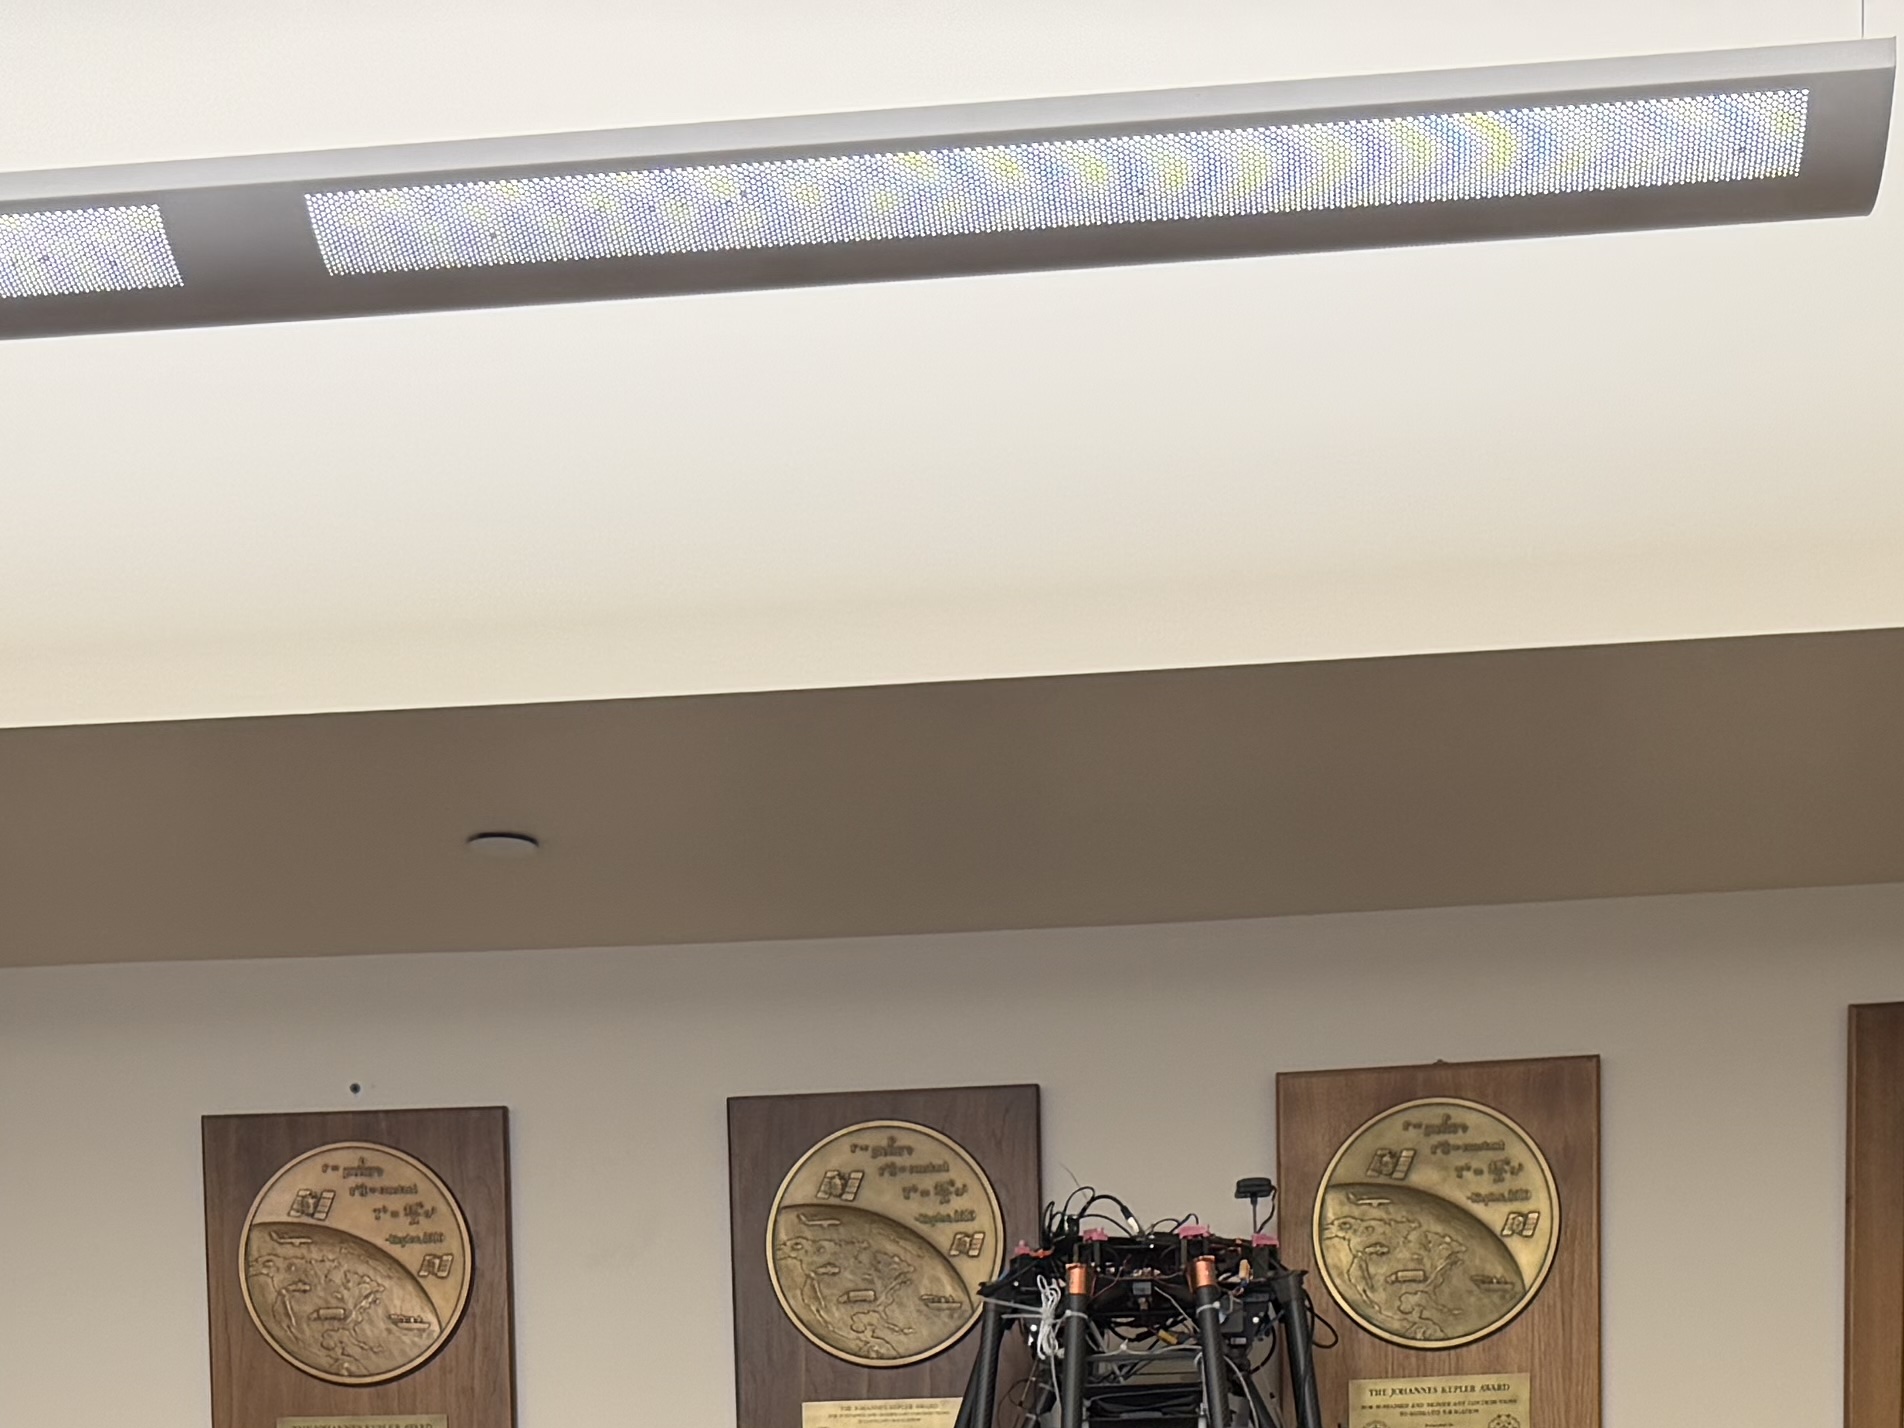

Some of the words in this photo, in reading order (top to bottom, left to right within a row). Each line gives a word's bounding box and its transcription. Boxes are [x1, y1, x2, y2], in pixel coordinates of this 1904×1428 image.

[1369, 1388, 1387, 1397] THE
[1389, 1386, 1438, 1399] JOHANNES
[1441, 1384, 1476, 1394] KEPLER
[1479, 1383, 1511, 1392] AWARD
